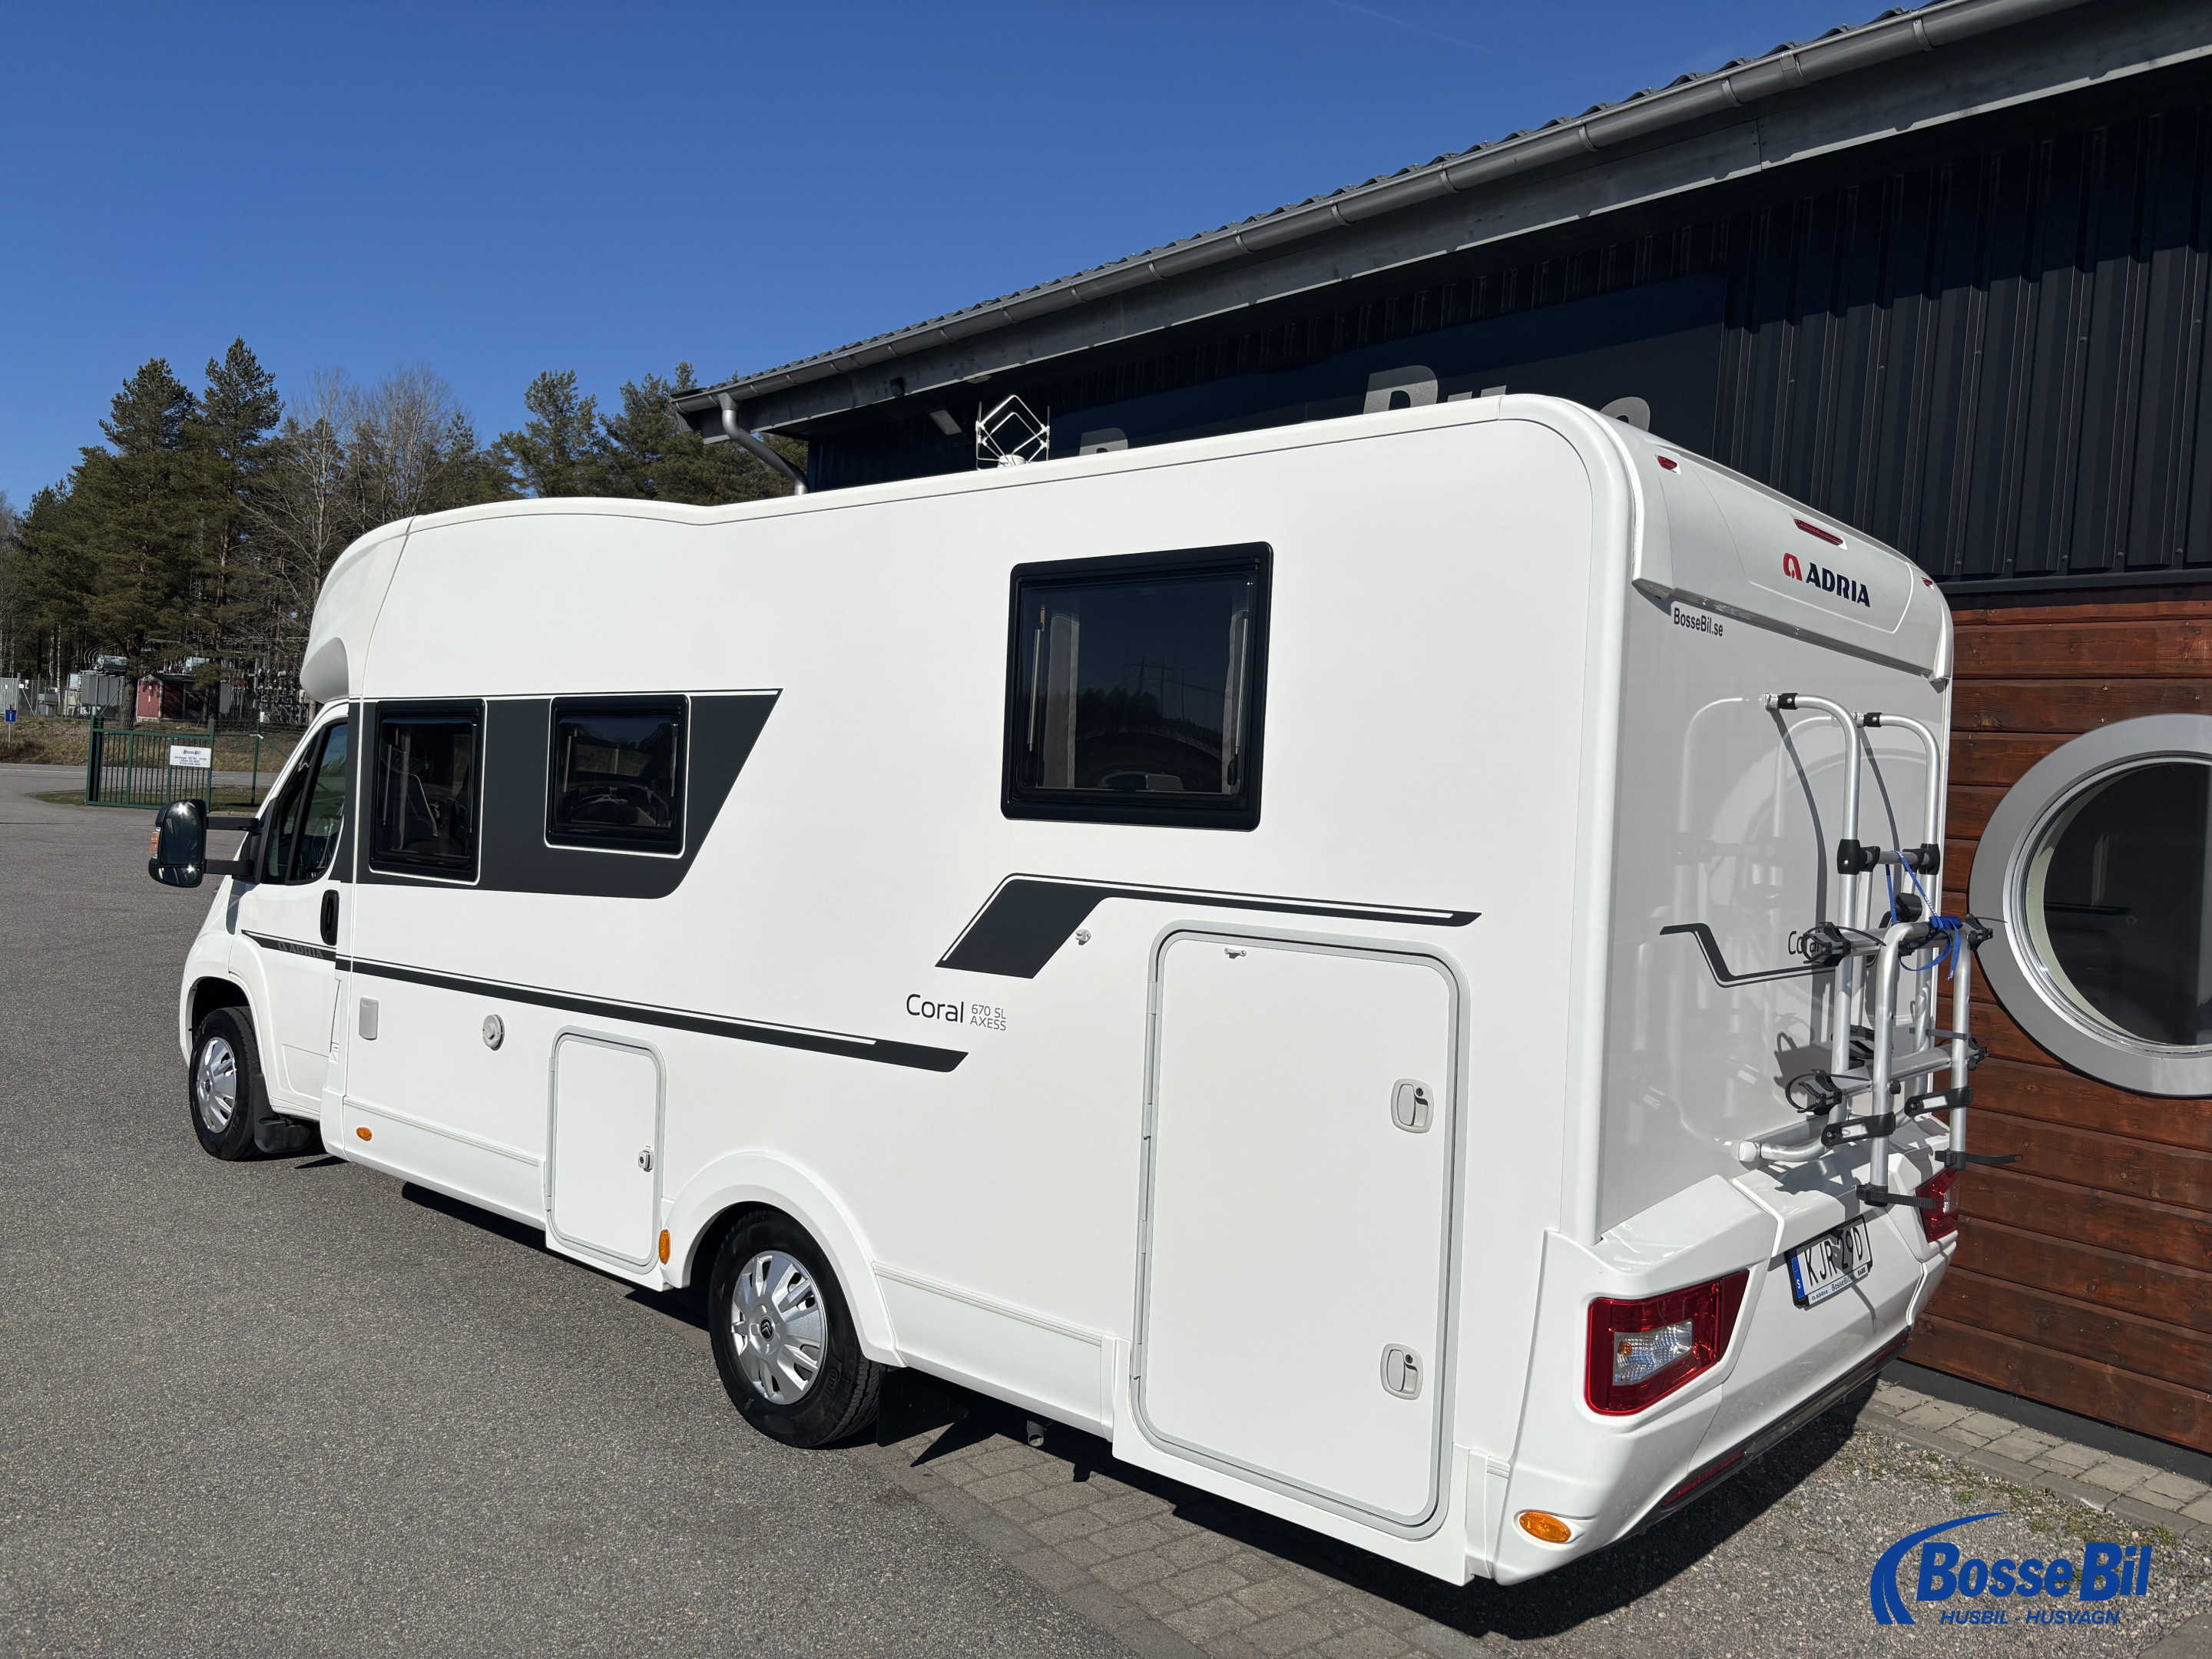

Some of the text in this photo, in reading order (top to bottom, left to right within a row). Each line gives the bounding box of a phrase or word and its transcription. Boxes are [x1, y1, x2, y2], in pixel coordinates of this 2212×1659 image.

[1806, 562, 1870, 608] ADRIA
[1673, 607, 1724, 637] BosseBil.se
[289, 943, 324, 959] ADRIA
[906, 993, 1007, 1023] Coral 670 SL
[969, 1015, 1007, 1031] AXESS
